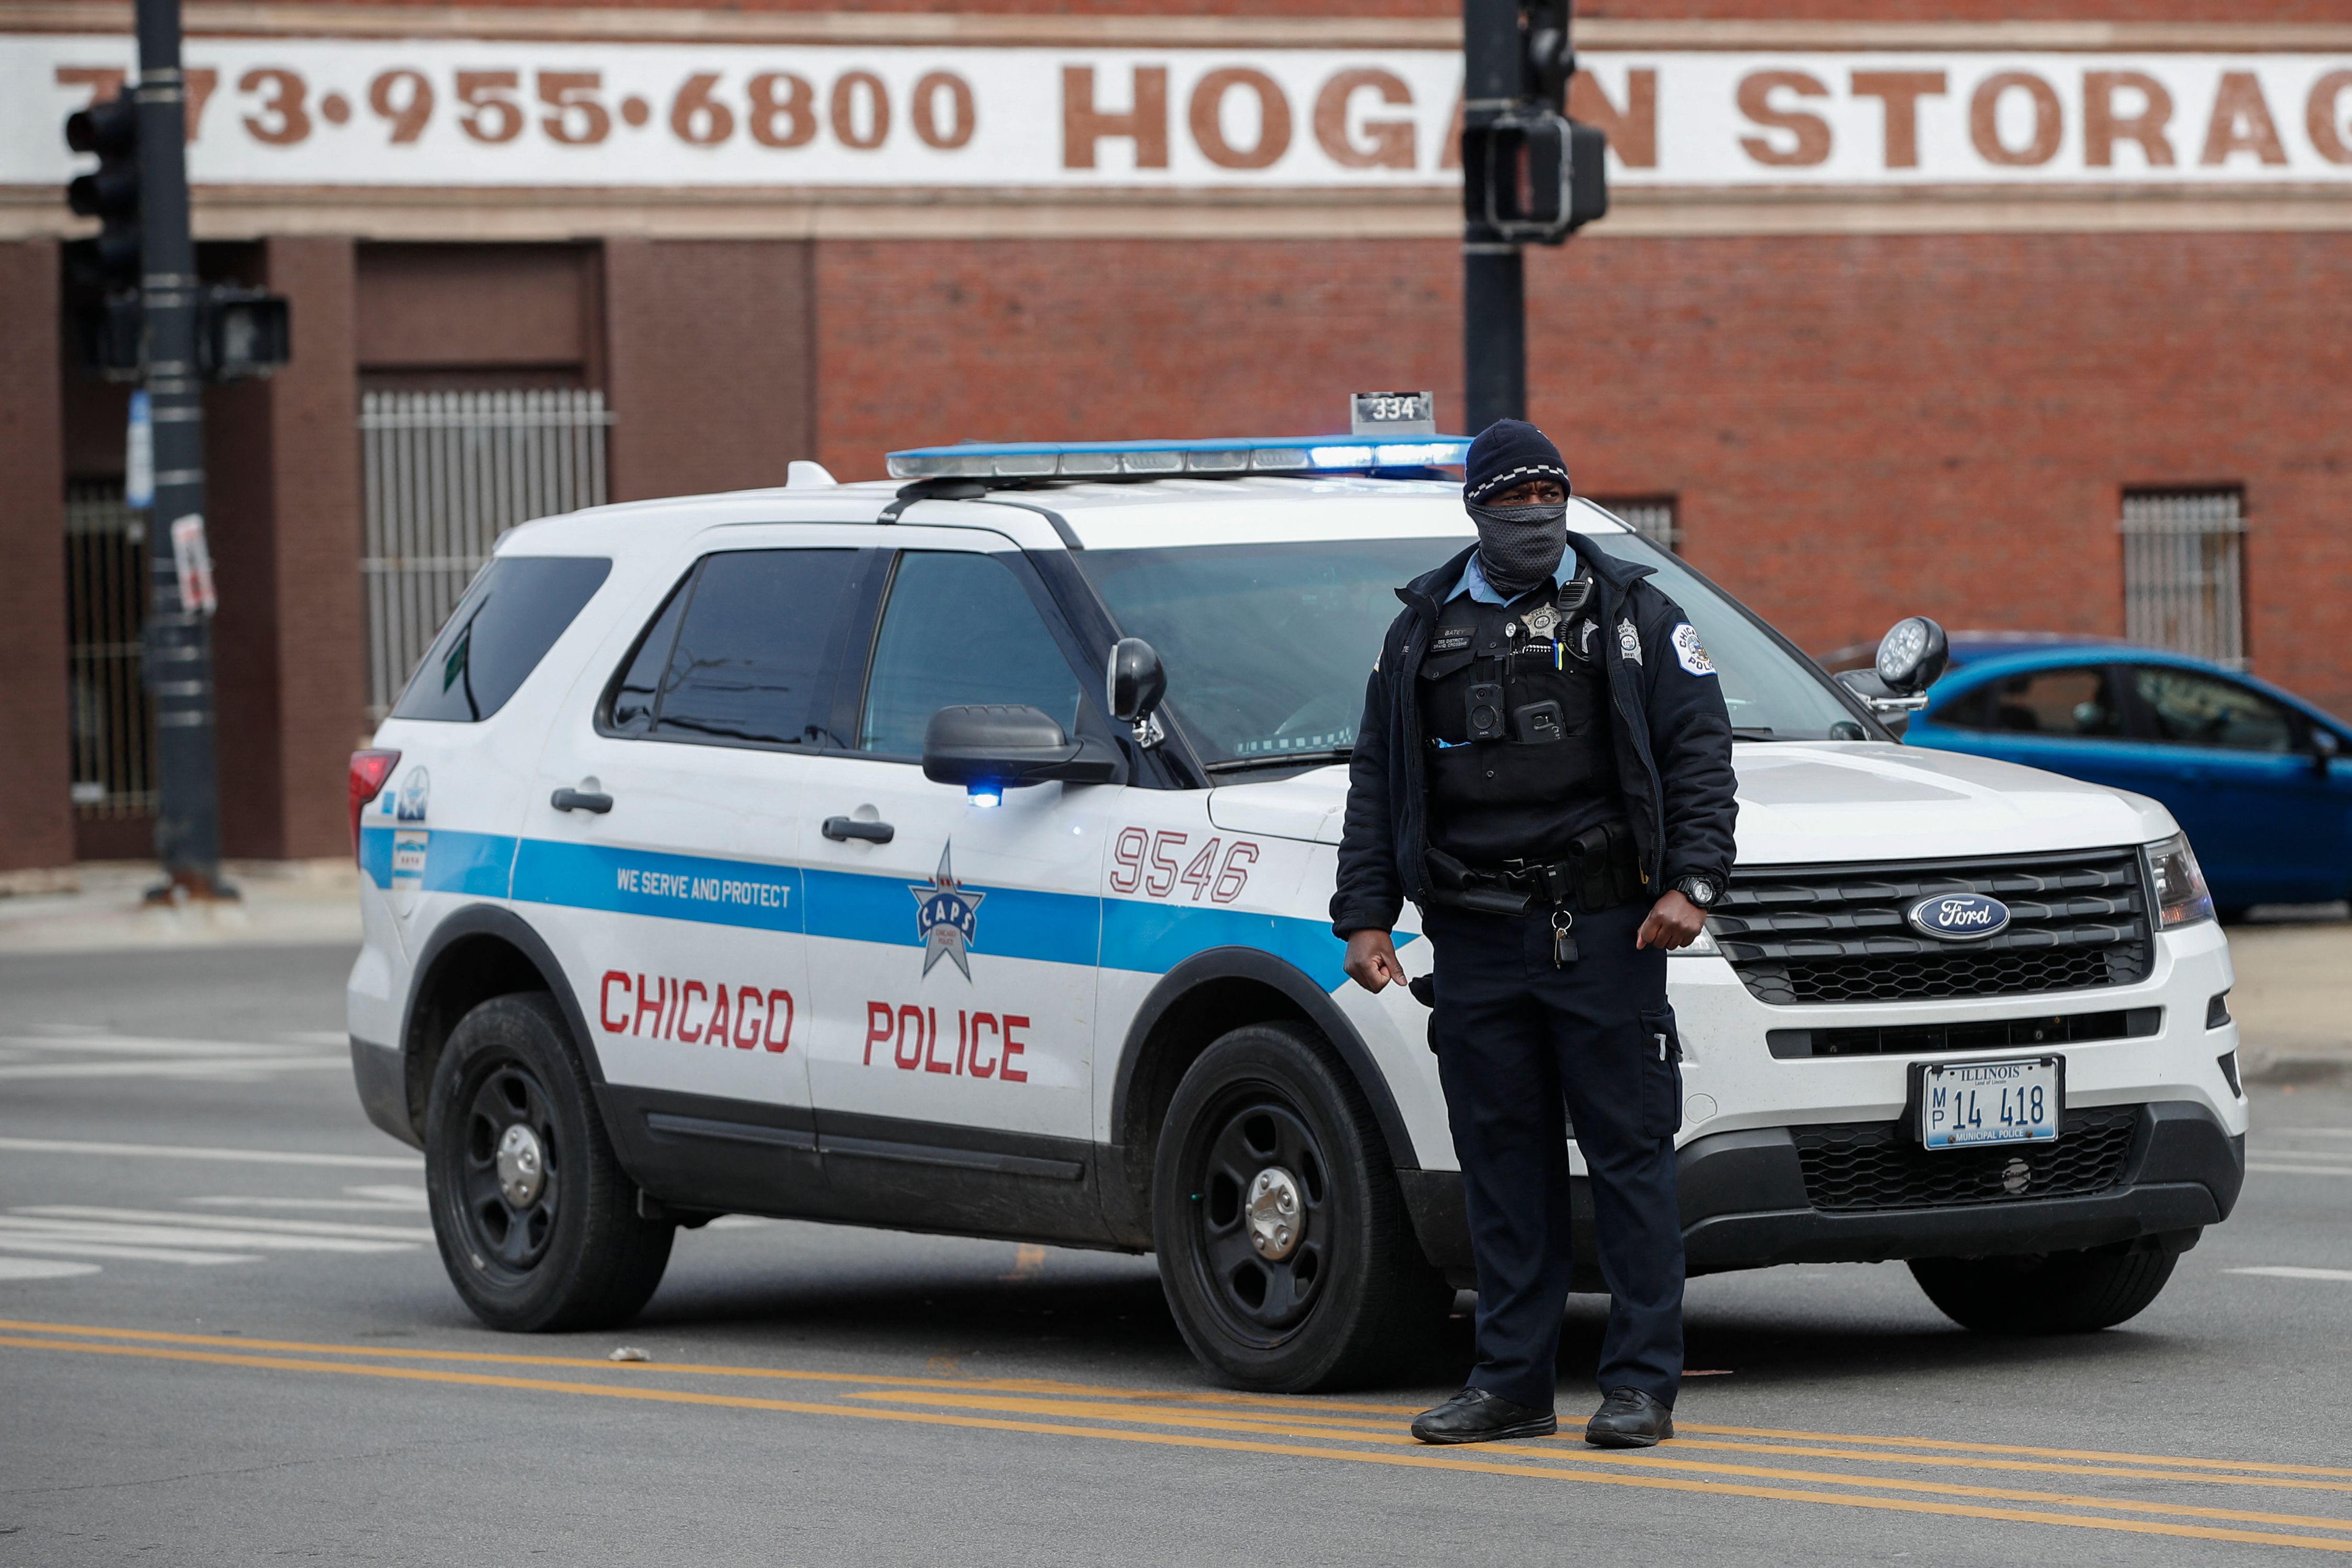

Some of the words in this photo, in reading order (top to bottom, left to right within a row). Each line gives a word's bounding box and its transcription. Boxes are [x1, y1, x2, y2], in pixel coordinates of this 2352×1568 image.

[1063, 66, 1657, 170] HOGN
[1373, 397, 1415, 420] 334
[1109, 826, 1260, 903] 9546
[617, 868, 640, 892] WE
[641, 871, 689, 898] SERVE
[690, 877, 720, 902] AND
[721, 880, 791, 908] PROTECT
[921, 900, 972, 931] CAPS
[1939, 900, 1991, 927] Ford
[600, 970, 794, 1054] CHICAGO
[863, 1000, 1031, 1083] POLICE
[1961, 1066, 2020, 1081] ILLINOIS
[2000, 1085, 2044, 1127] 418
[1956, 1132, 1997, 1142] MUNICIPAL
[1999, 1128, 2024, 1138] POLICE
